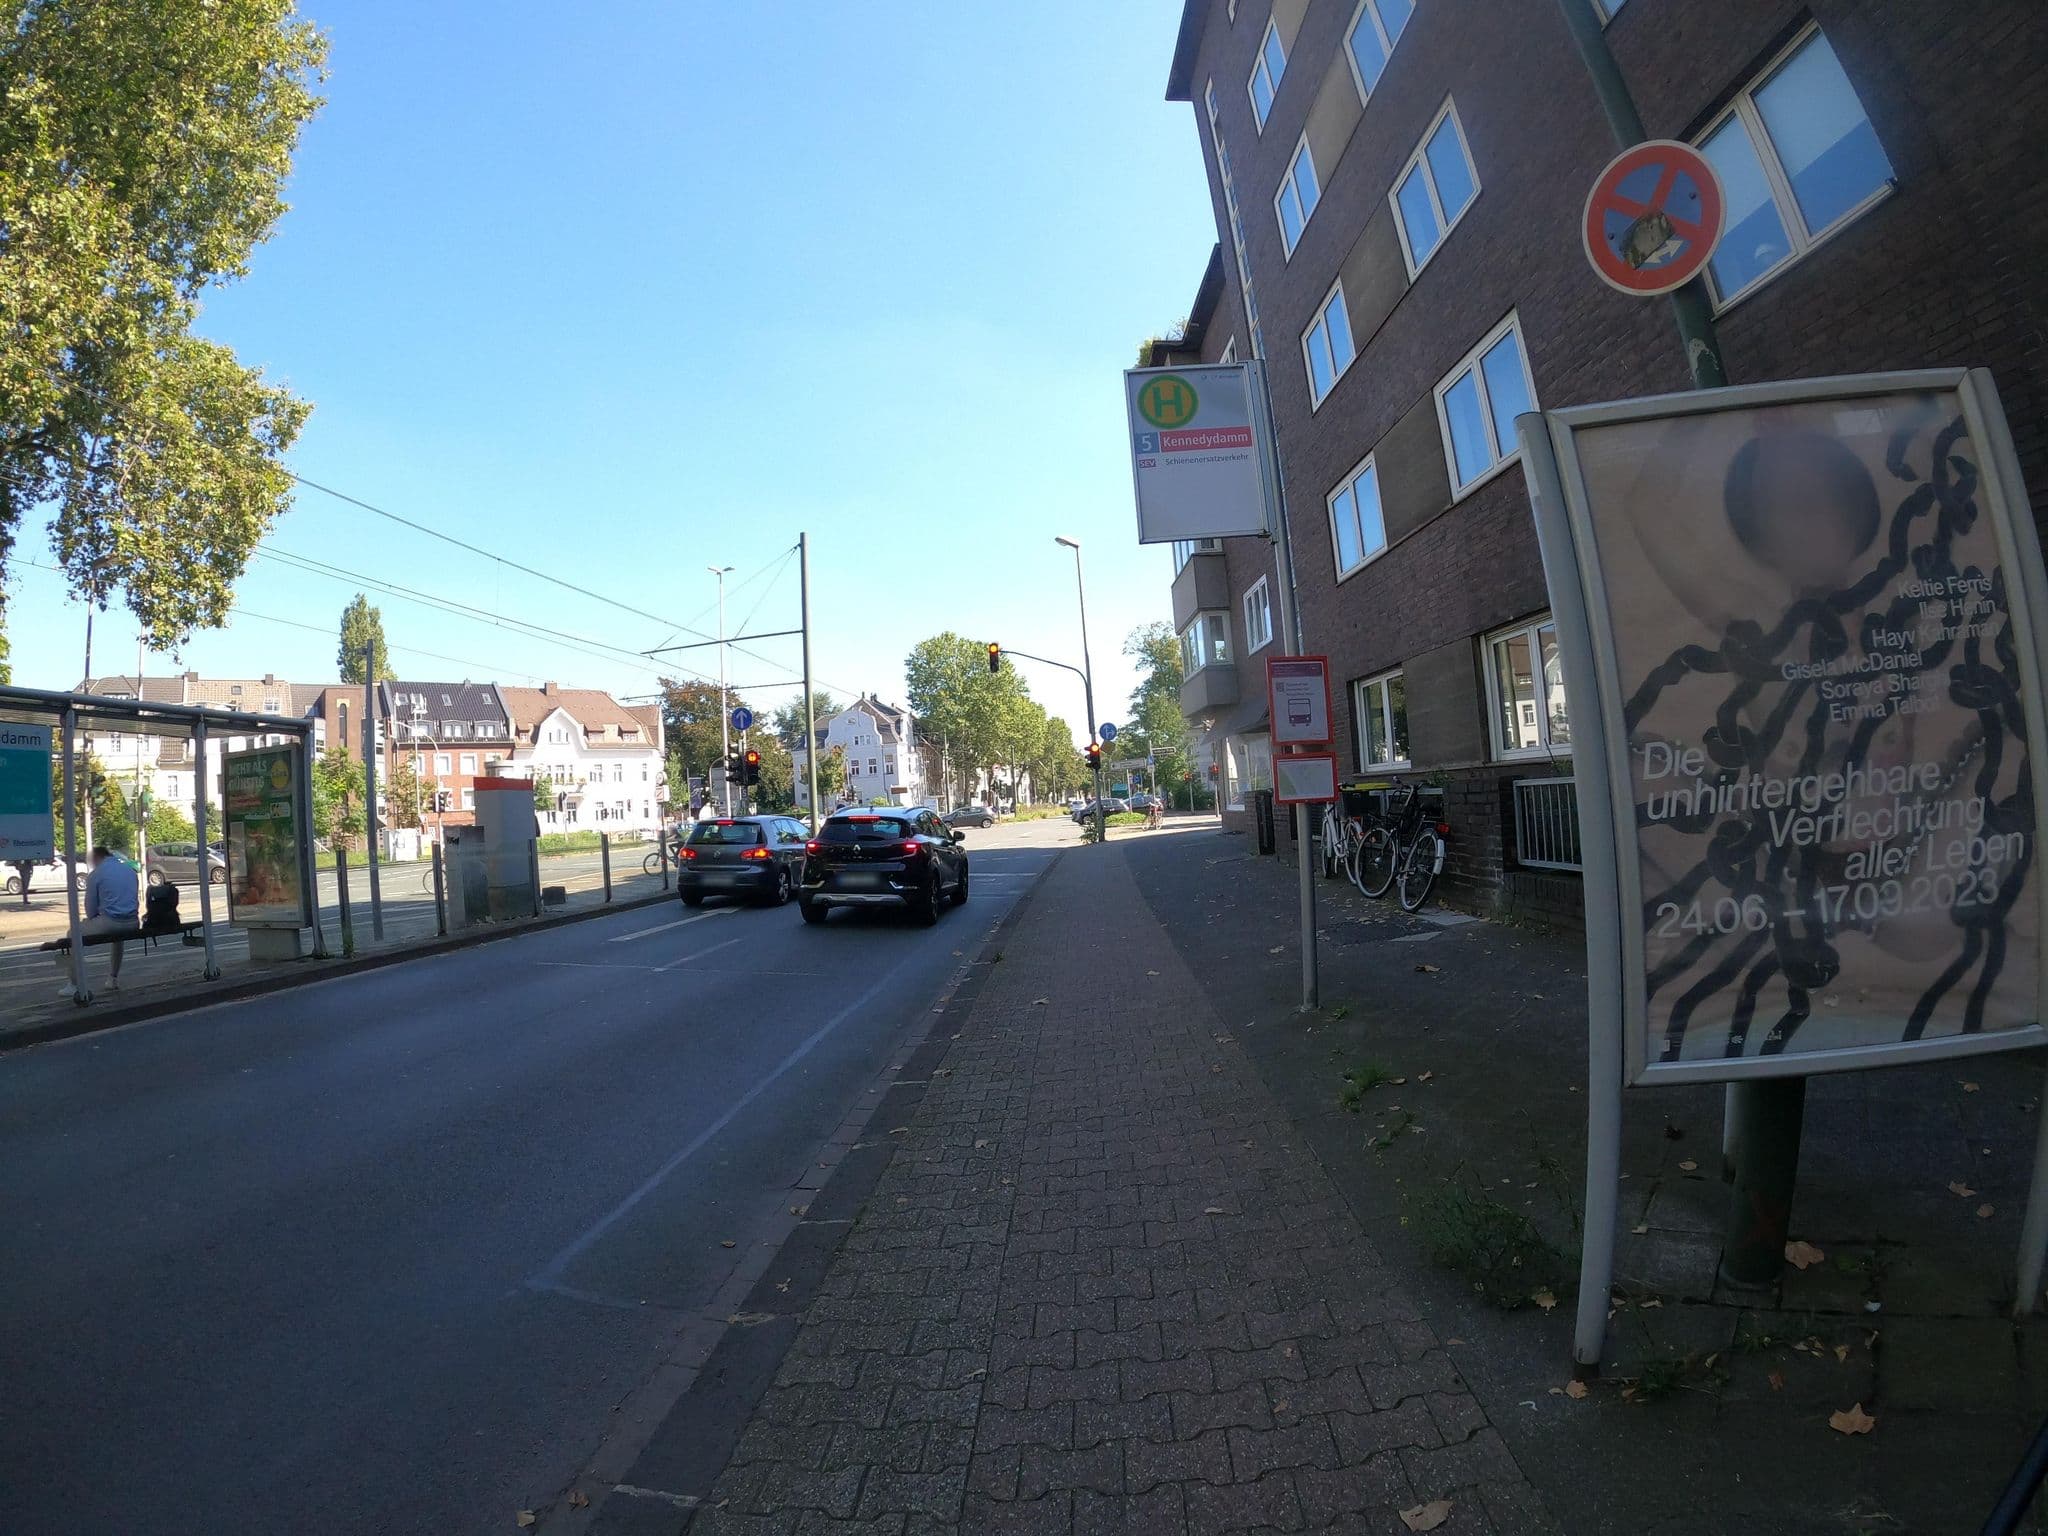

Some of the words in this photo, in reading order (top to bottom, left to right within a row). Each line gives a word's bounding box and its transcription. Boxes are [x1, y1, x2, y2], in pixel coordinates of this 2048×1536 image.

[1152, 385, 1184, 418] H
[1141, 434, 1152, 451] 5
[1163, 431, 1249, 448] Kennedydamm
[1139, 459, 1156, 468] SEV
[1165, 453, 1249, 466] Schienenersatzverkehr
[1899, 578, 1945, 599] Keltie
[1946, 574, 1993, 595] Ferris
[1872, 627, 1916, 650] Hayv
[1781, 658, 1838, 681] Gisela
[1841, 648, 1924, 674] McDaniel
[1820, 677, 1884, 700] Soraya
[1829, 702, 1887, 722] Emma
[0, 730, 41, 746] damm
[1642, 741, 1705, 780] Die
[1646, 760, 1941, 820] unhintergehbare
[1768, 796, 1987, 848] Verflechtung
[1844, 845, 1918, 880] aller
[1925, 831, 2025, 871] Leben
[1656, 894, 1776, 939] 24.06.
[1813, 868, 2000, 925] 17.09.2023
